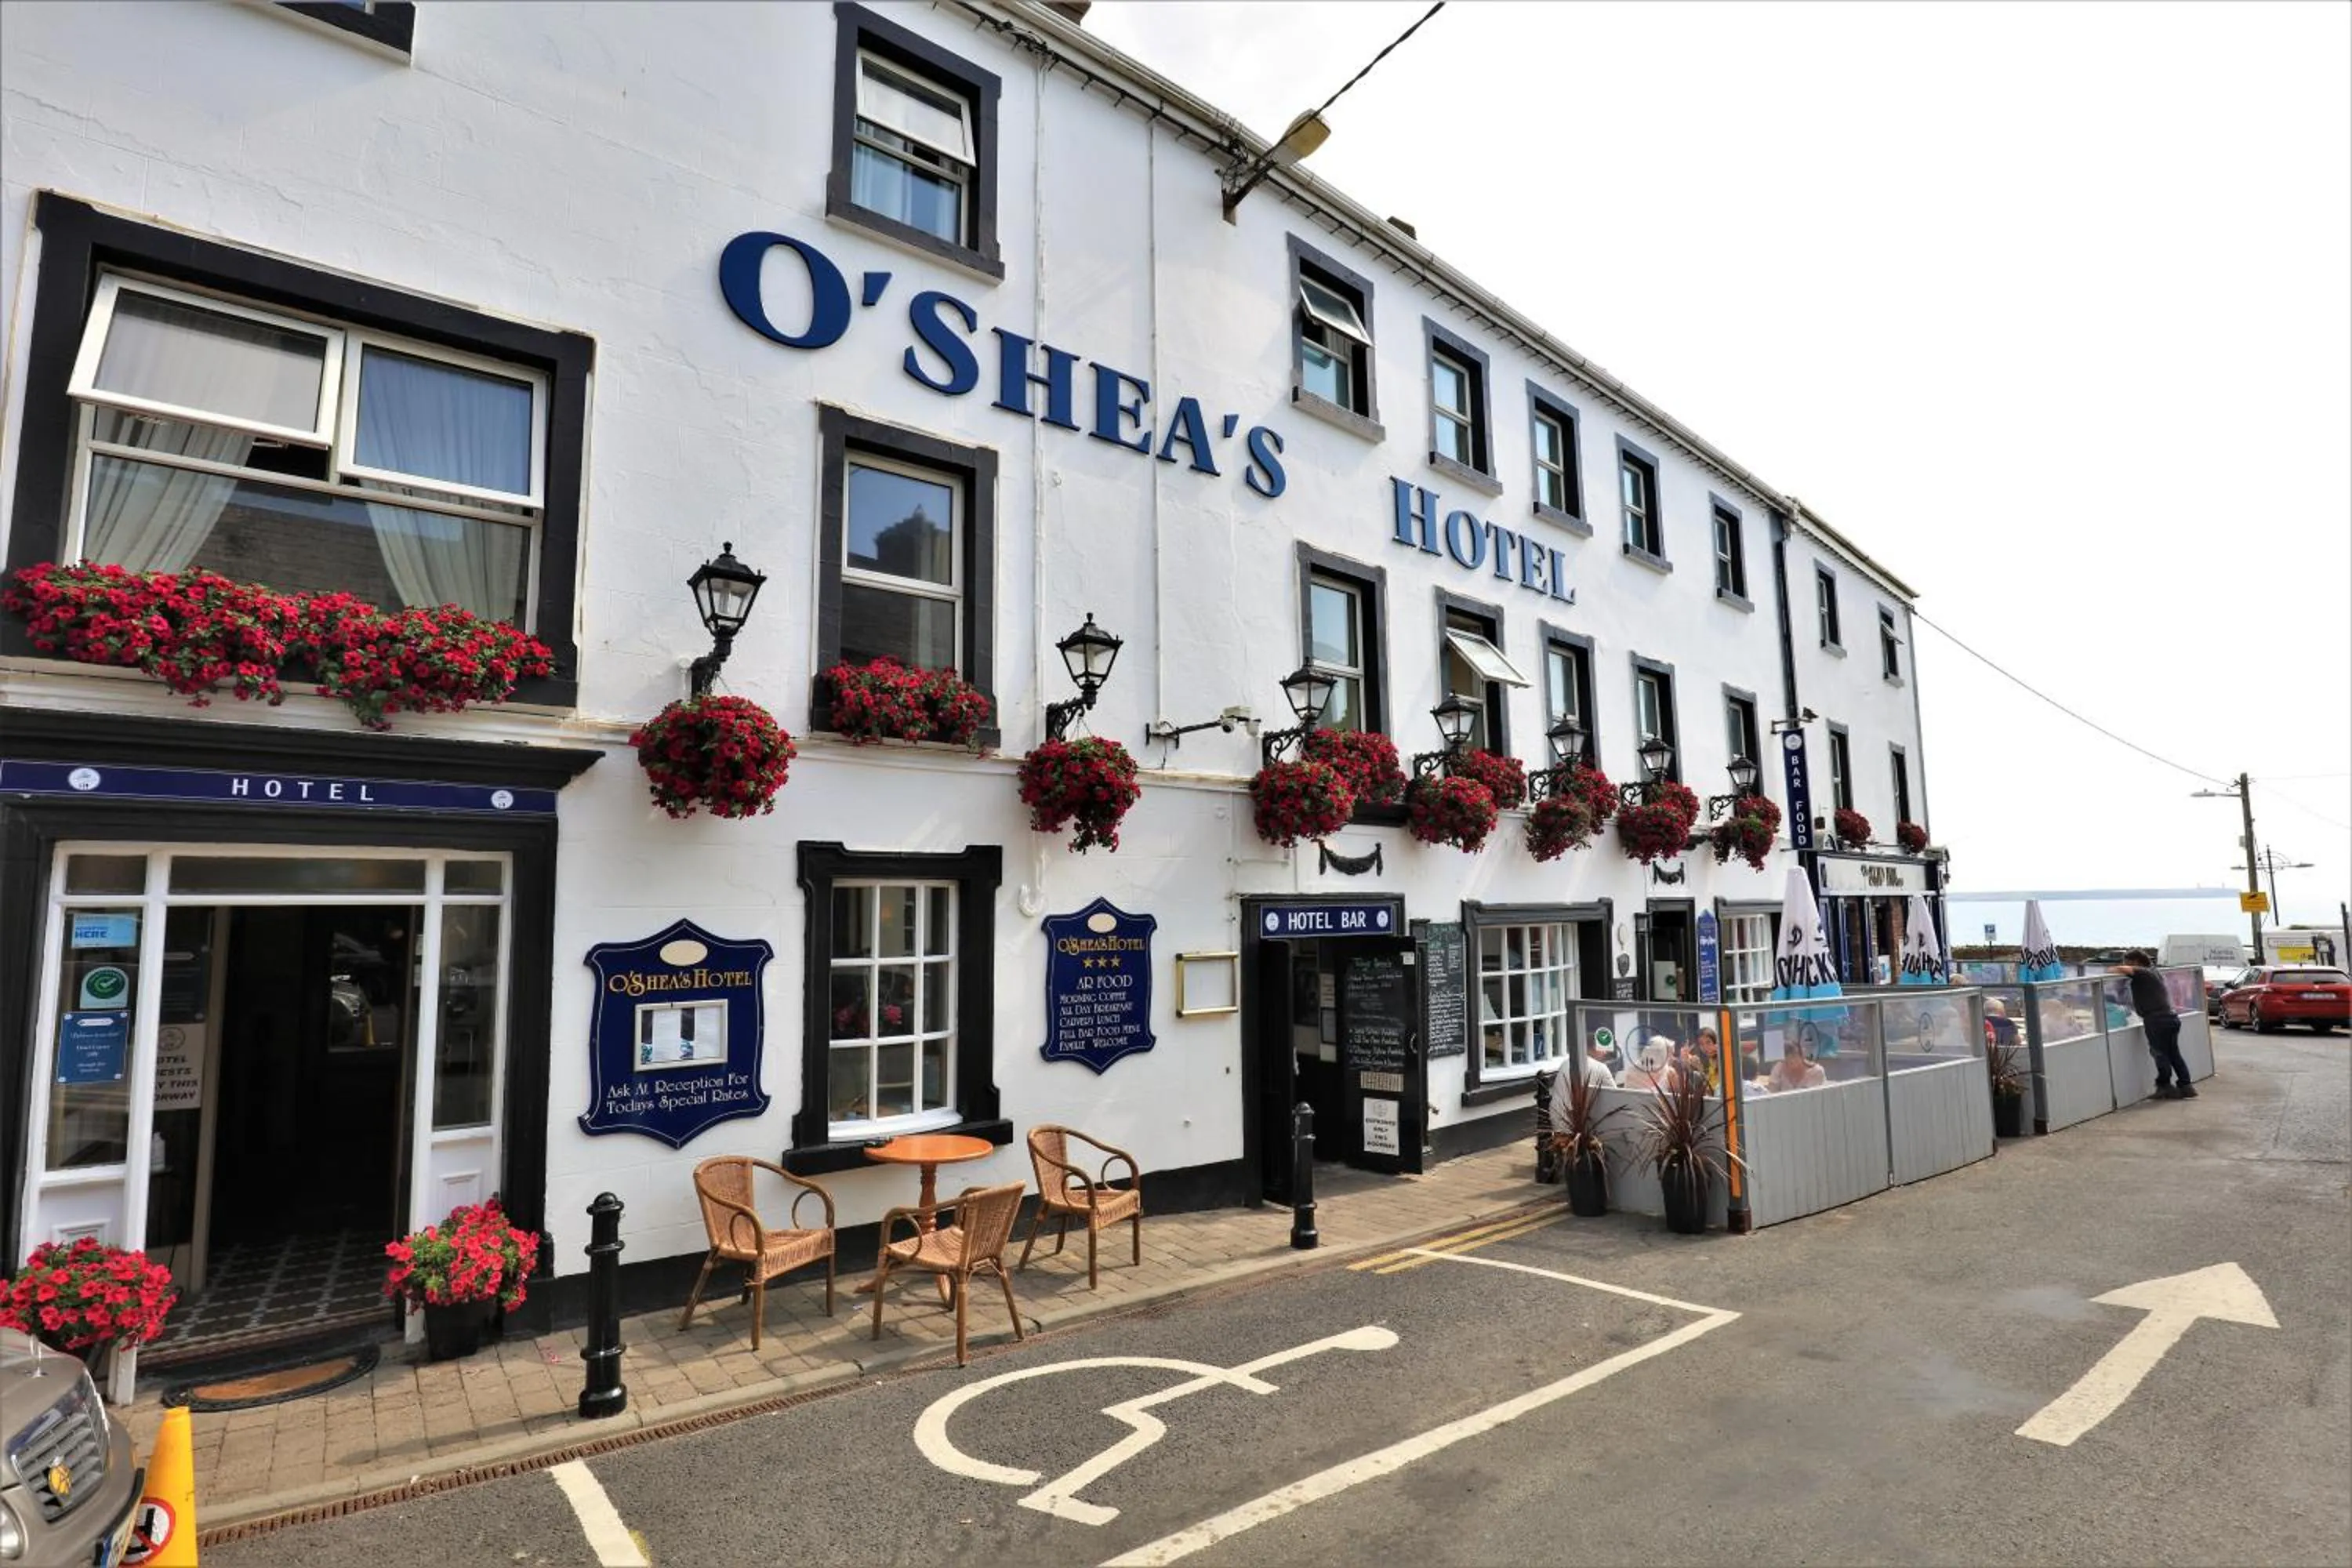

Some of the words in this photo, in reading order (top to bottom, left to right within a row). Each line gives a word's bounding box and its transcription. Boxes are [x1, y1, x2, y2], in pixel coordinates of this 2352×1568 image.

[719, 231, 1287, 499] O'SHEA'S
[1389, 475, 1576, 605] HOTEL
[1791, 755, 1801, 788] BAR
[231, 778, 374, 802] HOTEL
[1795, 800, 1807, 846] FOOD
[1288, 912, 1334, 931] HOTEL
[1341, 910, 1367, 928] BAR
[1057, 935, 1107, 956] O'SHEA'S
[1108, 935, 1145, 951] HOTEL
[609, 970, 692, 996] O'SHEA'S
[693, 968, 753, 988] HOTEL
[1097, 975, 1134, 989] FOOD
[1059, 993, 1097, 1004] MORNING
[1098, 992, 1127, 1002] COFFEE
[1060, 1006, 1073, 1016] ALL
[1075, 1005, 1092, 1015] DAY
[1094, 1003, 1134, 1014] BREAKFAST
[1060, 1016, 1094, 1027] CARVERY
[1097, 1014, 1120, 1025] LUNCH
[1059, 1029, 1076, 1040] FULL
[1078, 1027, 1094, 1039] BAR
[1097, 1025, 1120, 1036] FOOD
[1092, 1036, 1129, 1049] WELCOME
[607, 1083, 631, 1098] Ask
[635, 1083, 649, 1096] At
[654, 1075, 724, 1094] Reception
[728, 1073, 750, 1086] For
[606, 1099, 655, 1116] Todays
[659, 1091, 707, 1112] Special
[711, 1089, 750, 1103] Rates
